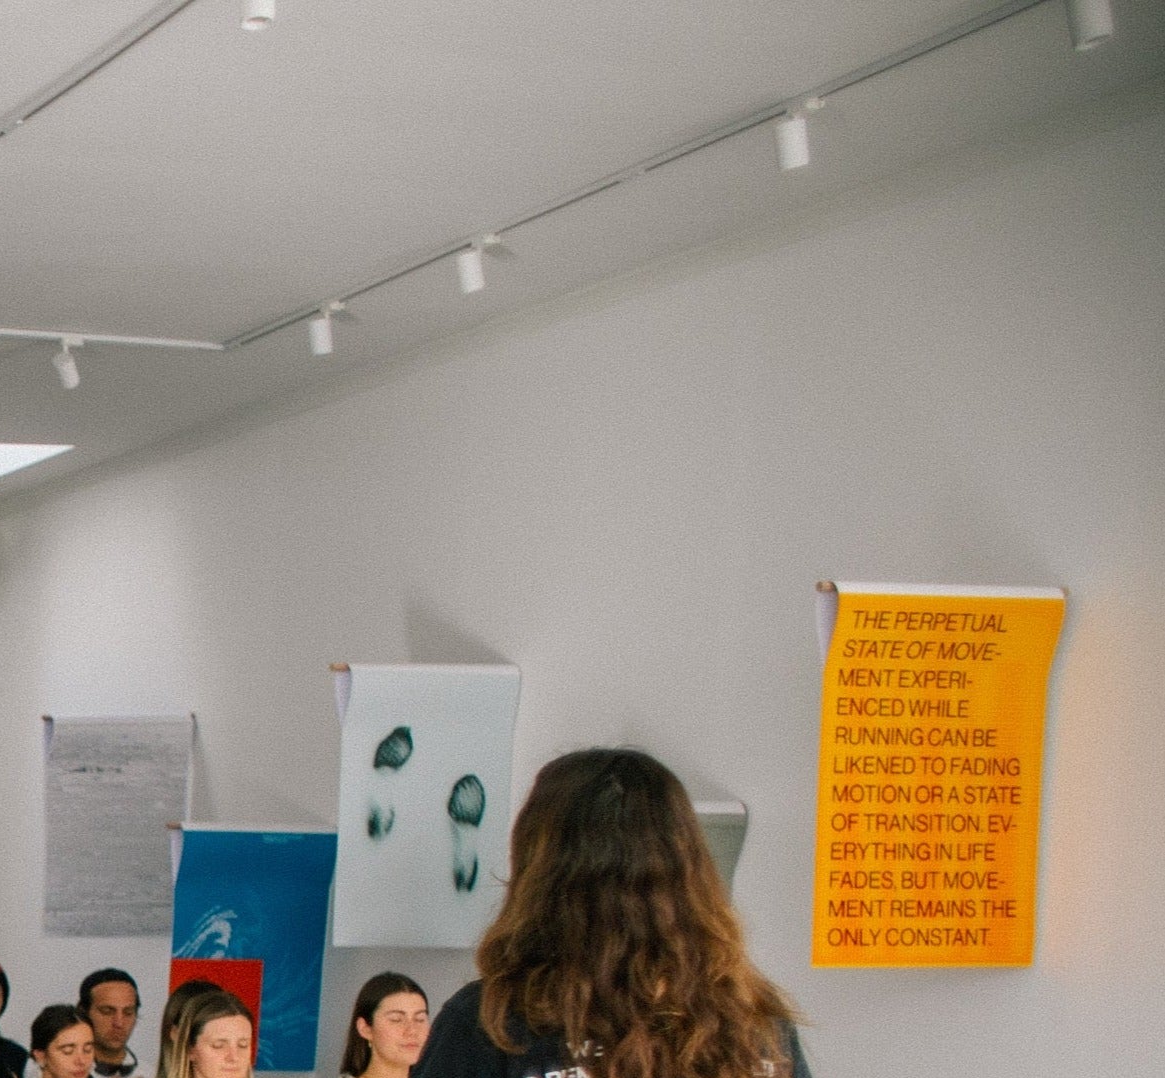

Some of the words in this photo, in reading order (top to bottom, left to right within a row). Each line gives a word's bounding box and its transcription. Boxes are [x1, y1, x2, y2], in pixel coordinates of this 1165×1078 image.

[853, 610, 892, 630] THE
[894, 611, 1007, 633] PERPETUAL
[843, 640, 904, 659] STATE
[906, 641, 936, 659] OF
[937, 642, 1002, 661] MOVE-
[838, 669, 895, 688] MENT
[898, 669, 972, 689] EXPERI-
[836, 698, 904, 716] ENCED
[909, 699, 969, 718] WHILE
[835, 727, 924, 746] RUNNING
[928, 728, 968, 746] CAN
[972, 729, 997, 747] BE
[833, 756, 915, 775] LIKENED
[921, 756, 946, 775] TO
[950, 757, 1020, 777] FADING
[833, 784, 911, 804] MOTION
[915, 785, 943, 804] OR
[949, 786, 960, 804] A
[963, 786, 1021, 805] STATE
[831, 813, 859, 832] OF
[864, 814, 983, 833] TRANSITION.
[988, 815, 1017, 833] EV-
[830, 842, 931, 861] ERYTHING
[935, 843, 952, 860] IN
[957, 843, 995, 861] LIFE
[829, 871, 897, 890] FADES,
[901, 871, 939, 889] BUT
[943, 872, 1005, 890] MOVE-
[828, 900, 885, 918] MENT
[890, 900, 976, 918] REMAINS
[982, 900, 1017, 918] THE
[827, 928, 881, 947] ONLY
[885, 928, 993, 947] CONSTANT.
